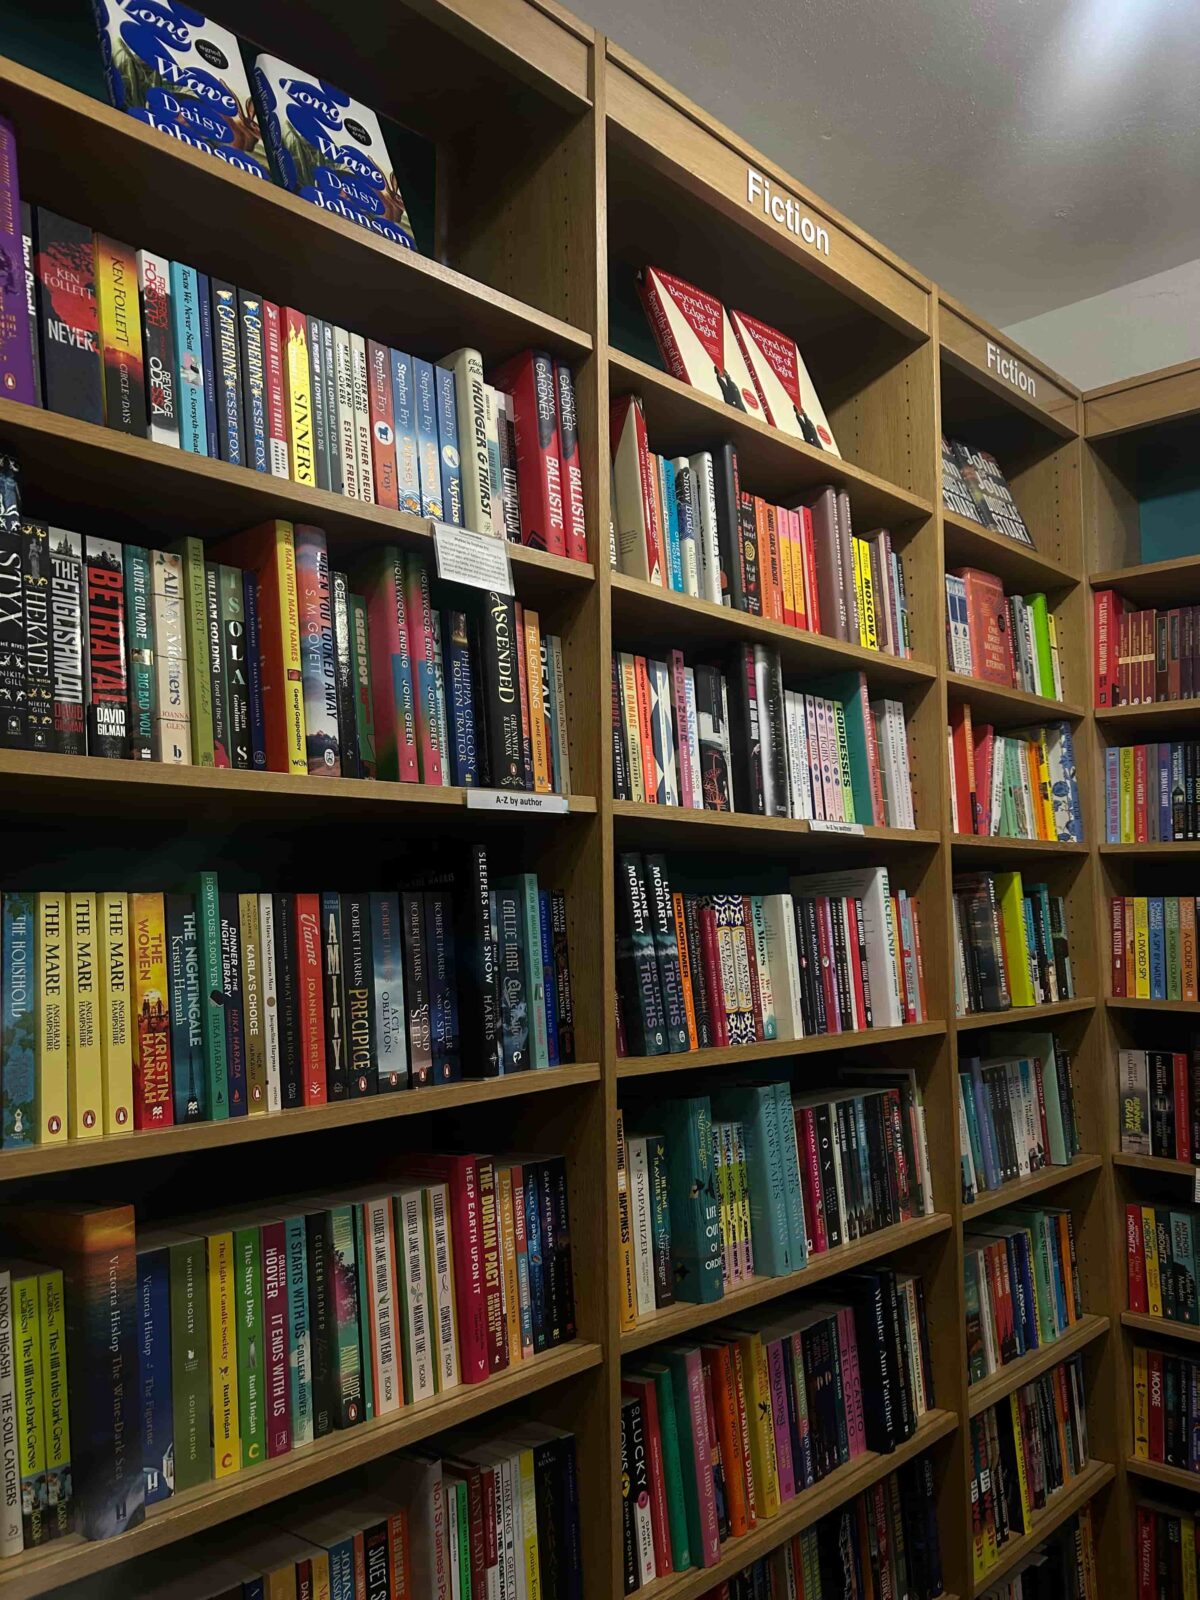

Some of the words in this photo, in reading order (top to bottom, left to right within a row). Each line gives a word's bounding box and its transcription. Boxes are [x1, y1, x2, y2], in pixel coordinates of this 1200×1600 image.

[121, 0, 191, 45] Long
[154, 55, 235, 108] Wave
[283, 80, 342, 124] Long
[161, 93, 227, 139] Daisy
[144, 110, 262, 179] Johnson
[317, 136, 382, 183] Wave
[326, 171, 379, 210] Daisy
[315, 190, 410, 247] Johnson
[746, 168, 830, 256] Fiction
[44, 272, 93, 300] FOLLETT
[56, 268, 80, 284] KEN
[111, 257, 124, 280] KEN
[144, 260, 159, 327] FORSYTH
[668, 284, 704, 311] Beyond
[705, 304, 720, 318] the
[682, 301, 706, 322] Edge
[708, 318, 717, 328] of
[48, 318, 93, 352] NEVER
[113, 284, 129, 346] FOLLETT
[217, 305, 237, 383] CATHERINE
[750, 328, 780, 350] Beyond
[780, 346, 794, 358] the
[762, 344, 782, 364] Edge
[120, 364, 128, 392] CIRCLE
[150, 357, 163, 414] ODESSA
[374, 350, 386, 392] Stephen
[396, 362, 408, 404] Stephen
[420, 370, 430, 411] Stephen
[987, 342, 1036, 398] Fiction
[122, 400, 132, 424] DAYS
[162, 371, 174, 418] REVENGE
[227, 388, 238, 435] ESSIE
[376, 395, 386, 415] Fry
[442, 377, 453, 418] Stephen
[536, 362, 551, 421] GARDNER
[560, 374, 574, 432] GARDNER
[294, 392, 312, 482] SINNERS
[398, 408, 410, 427] Fry
[422, 416, 432, 432] Fry
[444, 422, 454, 440] Fry
[472, 384, 488, 448] HUNGER
[230, 435, 240, 459] FOX
[344, 420, 353, 460] ESTHER
[478, 452, 488, 467] &
[346, 464, 355, 498] FREUD
[382, 462, 392, 492] Troy
[964, 446, 1002, 478] John
[450, 476, 460, 522] Mythos
[478, 466, 491, 519] THIRST
[502, 468, 520, 534] ULTIMATUM
[546, 456, 563, 530] BALLISTIC
[568, 466, 586, 539] BALLISTIC
[976, 470, 1012, 502] John
[284, 529, 292, 546] THE
[992, 512, 1032, 544] STUART
[52, 558, 80, 580] THE
[132, 558, 145, 592] LAURIE
[164, 569, 179, 594] All
[319, 552, 328, 590] WHEN
[0, 553, 24, 629] STYX
[208, 571, 218, 617] WILLIAM
[319, 596, 331, 622] YOU
[864, 578, 875, 636] MOSCOW
[26, 590, 48, 676] HEKATE
[134, 594, 148, 640] GILMORE
[288, 598, 296, 627] MANY
[88, 567, 127, 704] BETRAYAL
[210, 618, 221, 674] GOLDING
[290, 629, 298, 662] NAMES
[321, 624, 335, 678] LOOKED
[400, 629, 408, 668] ENDING
[490, 592, 515, 703] ASCENDED
[527, 624, 536, 646] THE
[166, 629, 181, 706] Mothers
[453, 660, 462, 707] BOLEYN
[461, 650, 472, 706] PHILIPPA
[530, 649, 540, 709] LIGHTNING
[324, 682, 338, 720] AWAY
[402, 680, 410, 708] JOHN
[96, 707, 125, 724] DAVID
[98, 724, 126, 738] GILMAN
[405, 713, 414, 746] GREEN
[456, 710, 468, 762] TRAITOR
[465, 709, 478, 774] GREGORY
[836, 707, 850, 786] GODDESSES
[496, 796, 508, 804] A-Z
[510, 798, 518, 806] by
[520, 798, 542, 807] author
[45, 902, 60, 938] THE
[76, 900, 91, 936] THE
[627, 865, 645, 934] MORIARTY
[638, 880, 649, 918] LIANE
[652, 866, 668, 934] MORIARTY
[882, 874, 896, 962] FIERCELAND
[11, 915, 26, 936] THE
[184, 912, 197, 940] THE
[300, 914, 318, 966] Vianne
[76, 942, 92, 993] MARE
[137, 918, 152, 981] WOMEN
[152, 933, 164, 964] THE
[246, 944, 256, 991] KARLA'S
[1184, 940, 1192, 969] COLDER
[12, 940, 27, 1018] HOUSEHOLD
[46, 944, 60, 996] MARE
[185, 946, 202, 1047] NIGHTINGALE
[307, 978, 316, 1024] JOANNE
[326, 913, 340, 1070] AMITY
[249, 993, 260, 1036] CHOICE
[350, 988, 370, 1070] PRECIPICE
[142, 1034, 156, 1104] HANNAH
[154, 1032, 170, 1102] KRISTIN
[310, 1026, 320, 1070] HARRIS
[465, 1166, 474, 1198] HEAP
[479, 1164, 492, 1190] THE
[468, 1203, 476, 1244] EARTH
[480, 1193, 496, 1250] DURIAN
[618, 1191, 630, 1244] HAPPINESS
[1128, 1214, 1136, 1252] HOROWITZ
[266, 1248, 278, 1299] HOOVER
[470, 1247, 480, 1281] UPON
[484, 1252, 499, 1288] PACT
[474, 1282, 481, 1295] IT
[1018, 1284, 1026, 1324] HAVOC
[271, 1313, 283, 1326] IT
[874, 1288, 886, 1342] Whistler
[272, 1327, 284, 1360] ENDS
[272, 1362, 284, 1395] WITH
[1152, 1370, 1161, 1407] MOORE
[274, 1398, 285, 1417] US
[883, 1379, 894, 1432] Patchett
[632, 1418, 646, 1486] LUCKY
